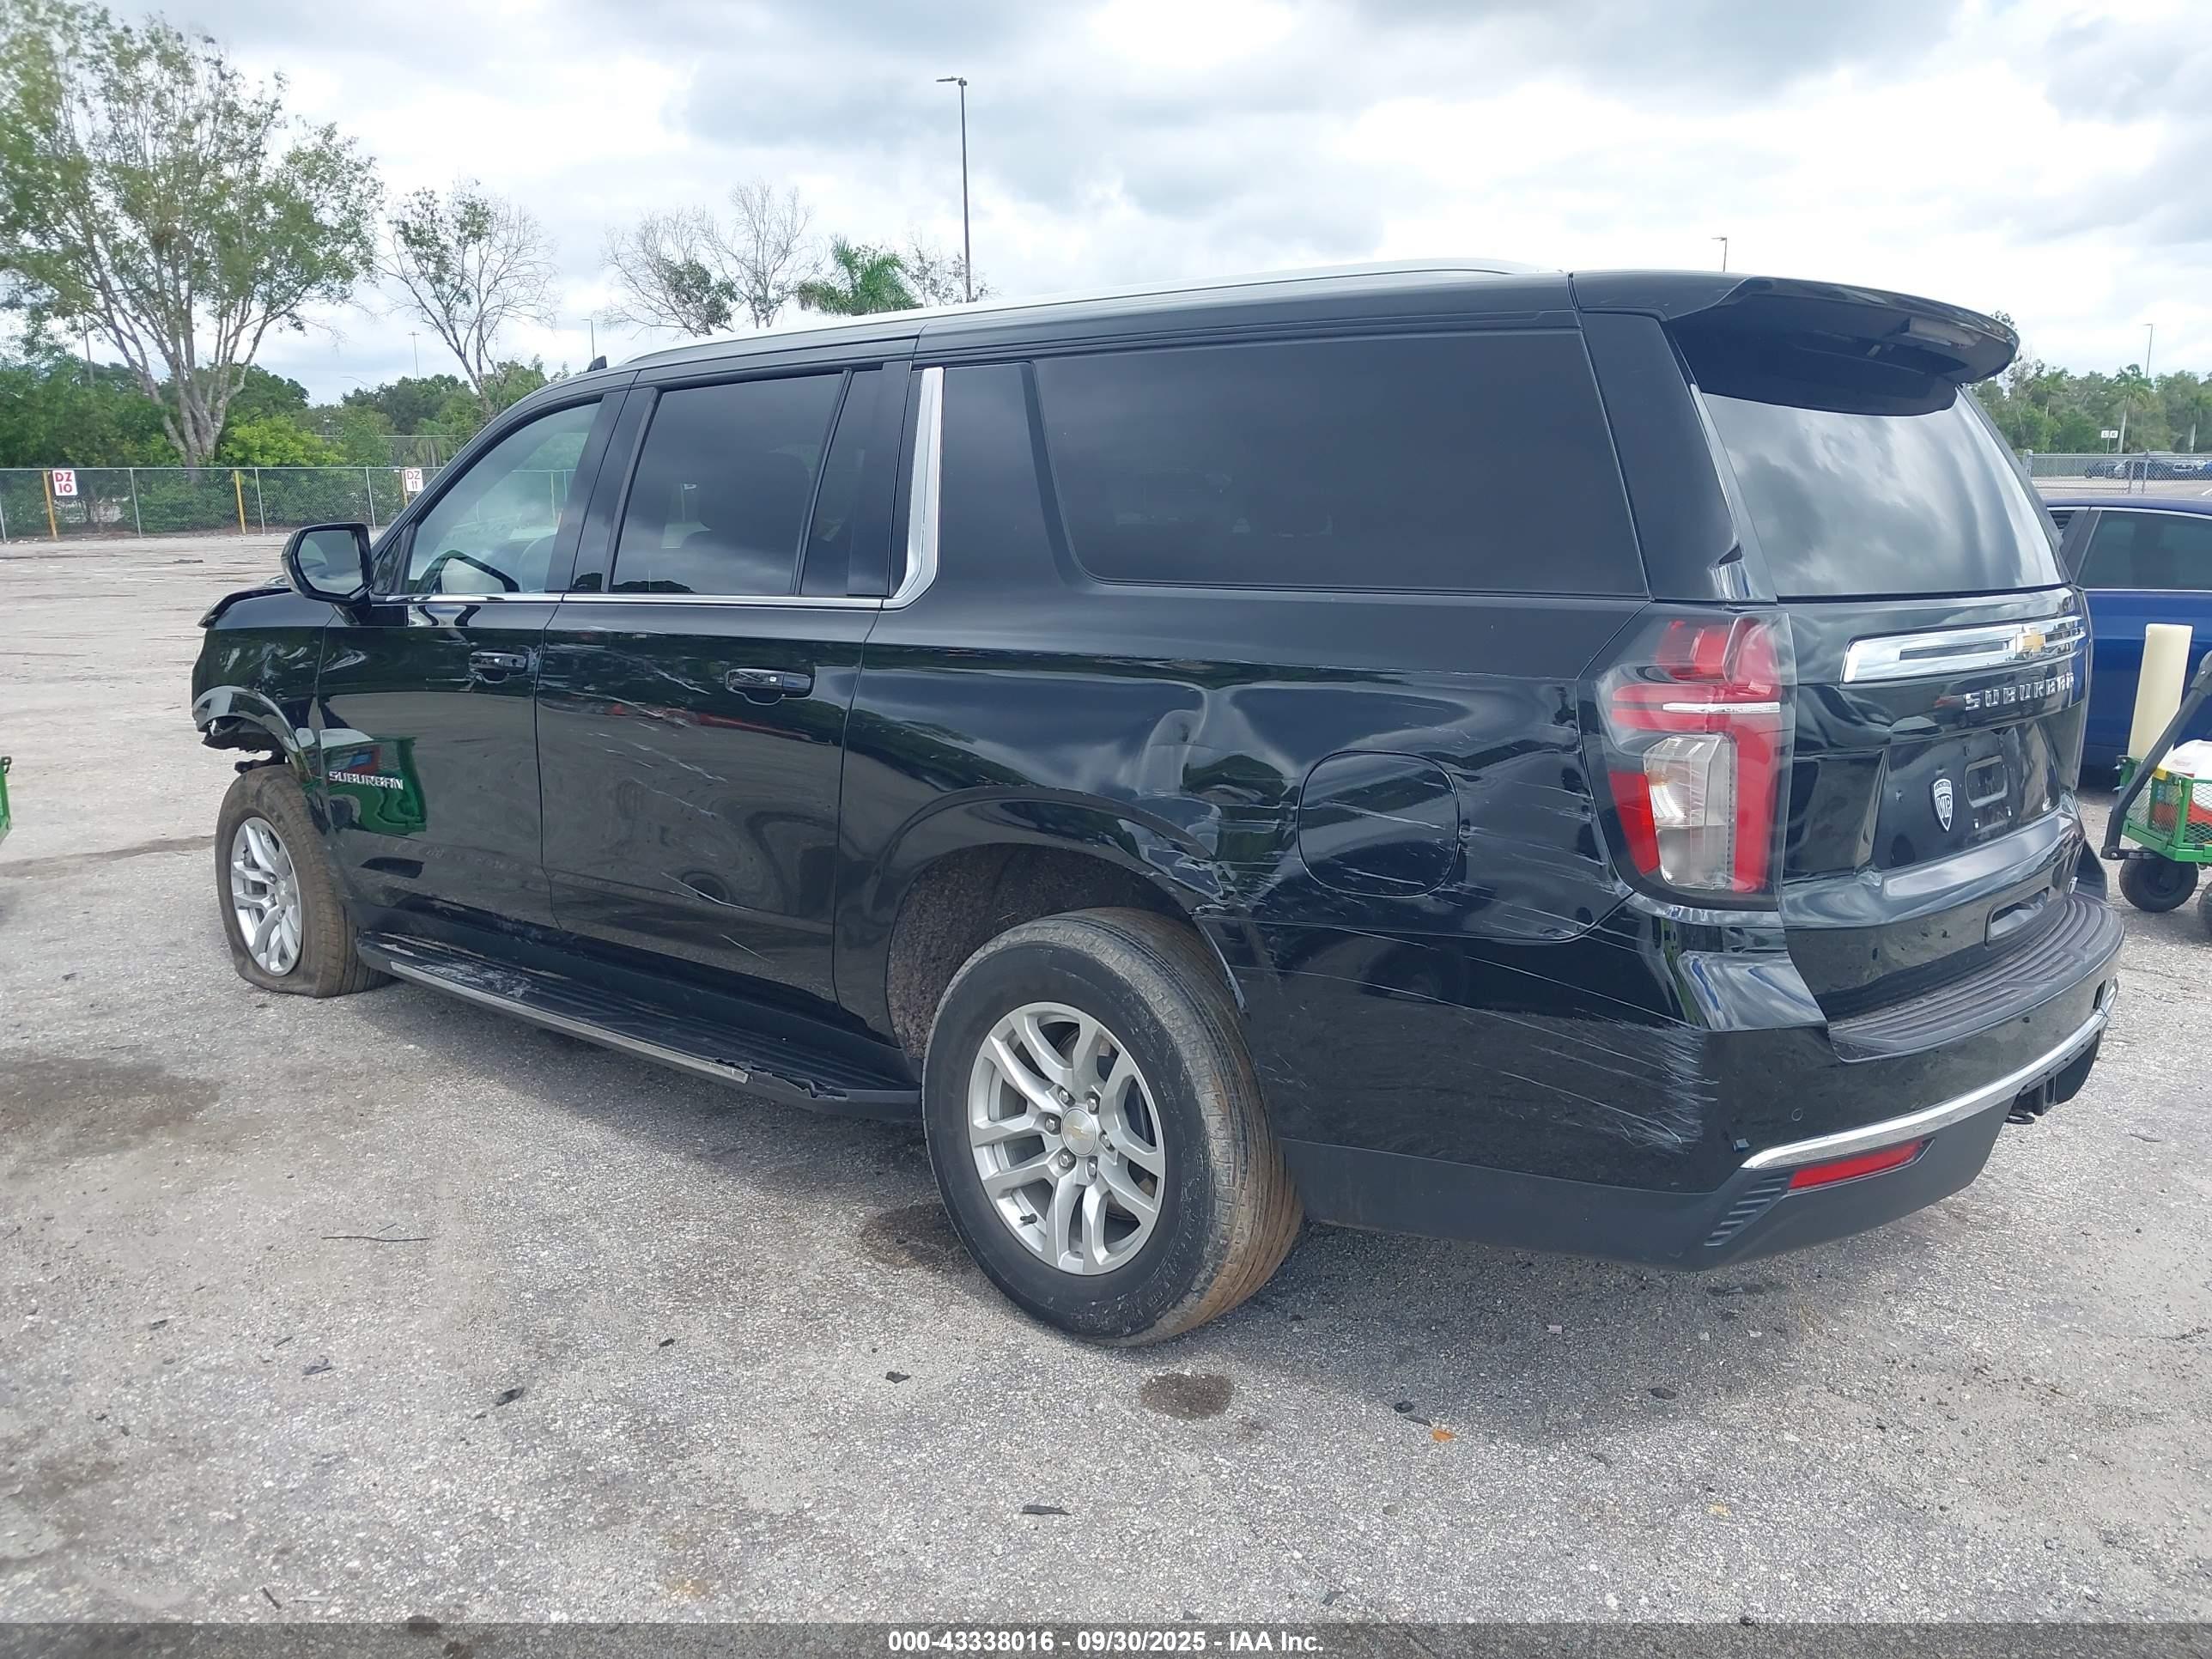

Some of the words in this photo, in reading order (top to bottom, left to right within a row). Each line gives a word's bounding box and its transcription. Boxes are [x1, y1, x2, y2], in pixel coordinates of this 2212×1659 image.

[55, 472, 72, 483] DZ
[407, 471, 421, 480] DZ
[58, 483, 73, 494] 10
[411, 481, 418, 490] 11
[1964, 672, 2075, 712] SUBURBAN
[329, 771, 404, 791] SUBURBAN
